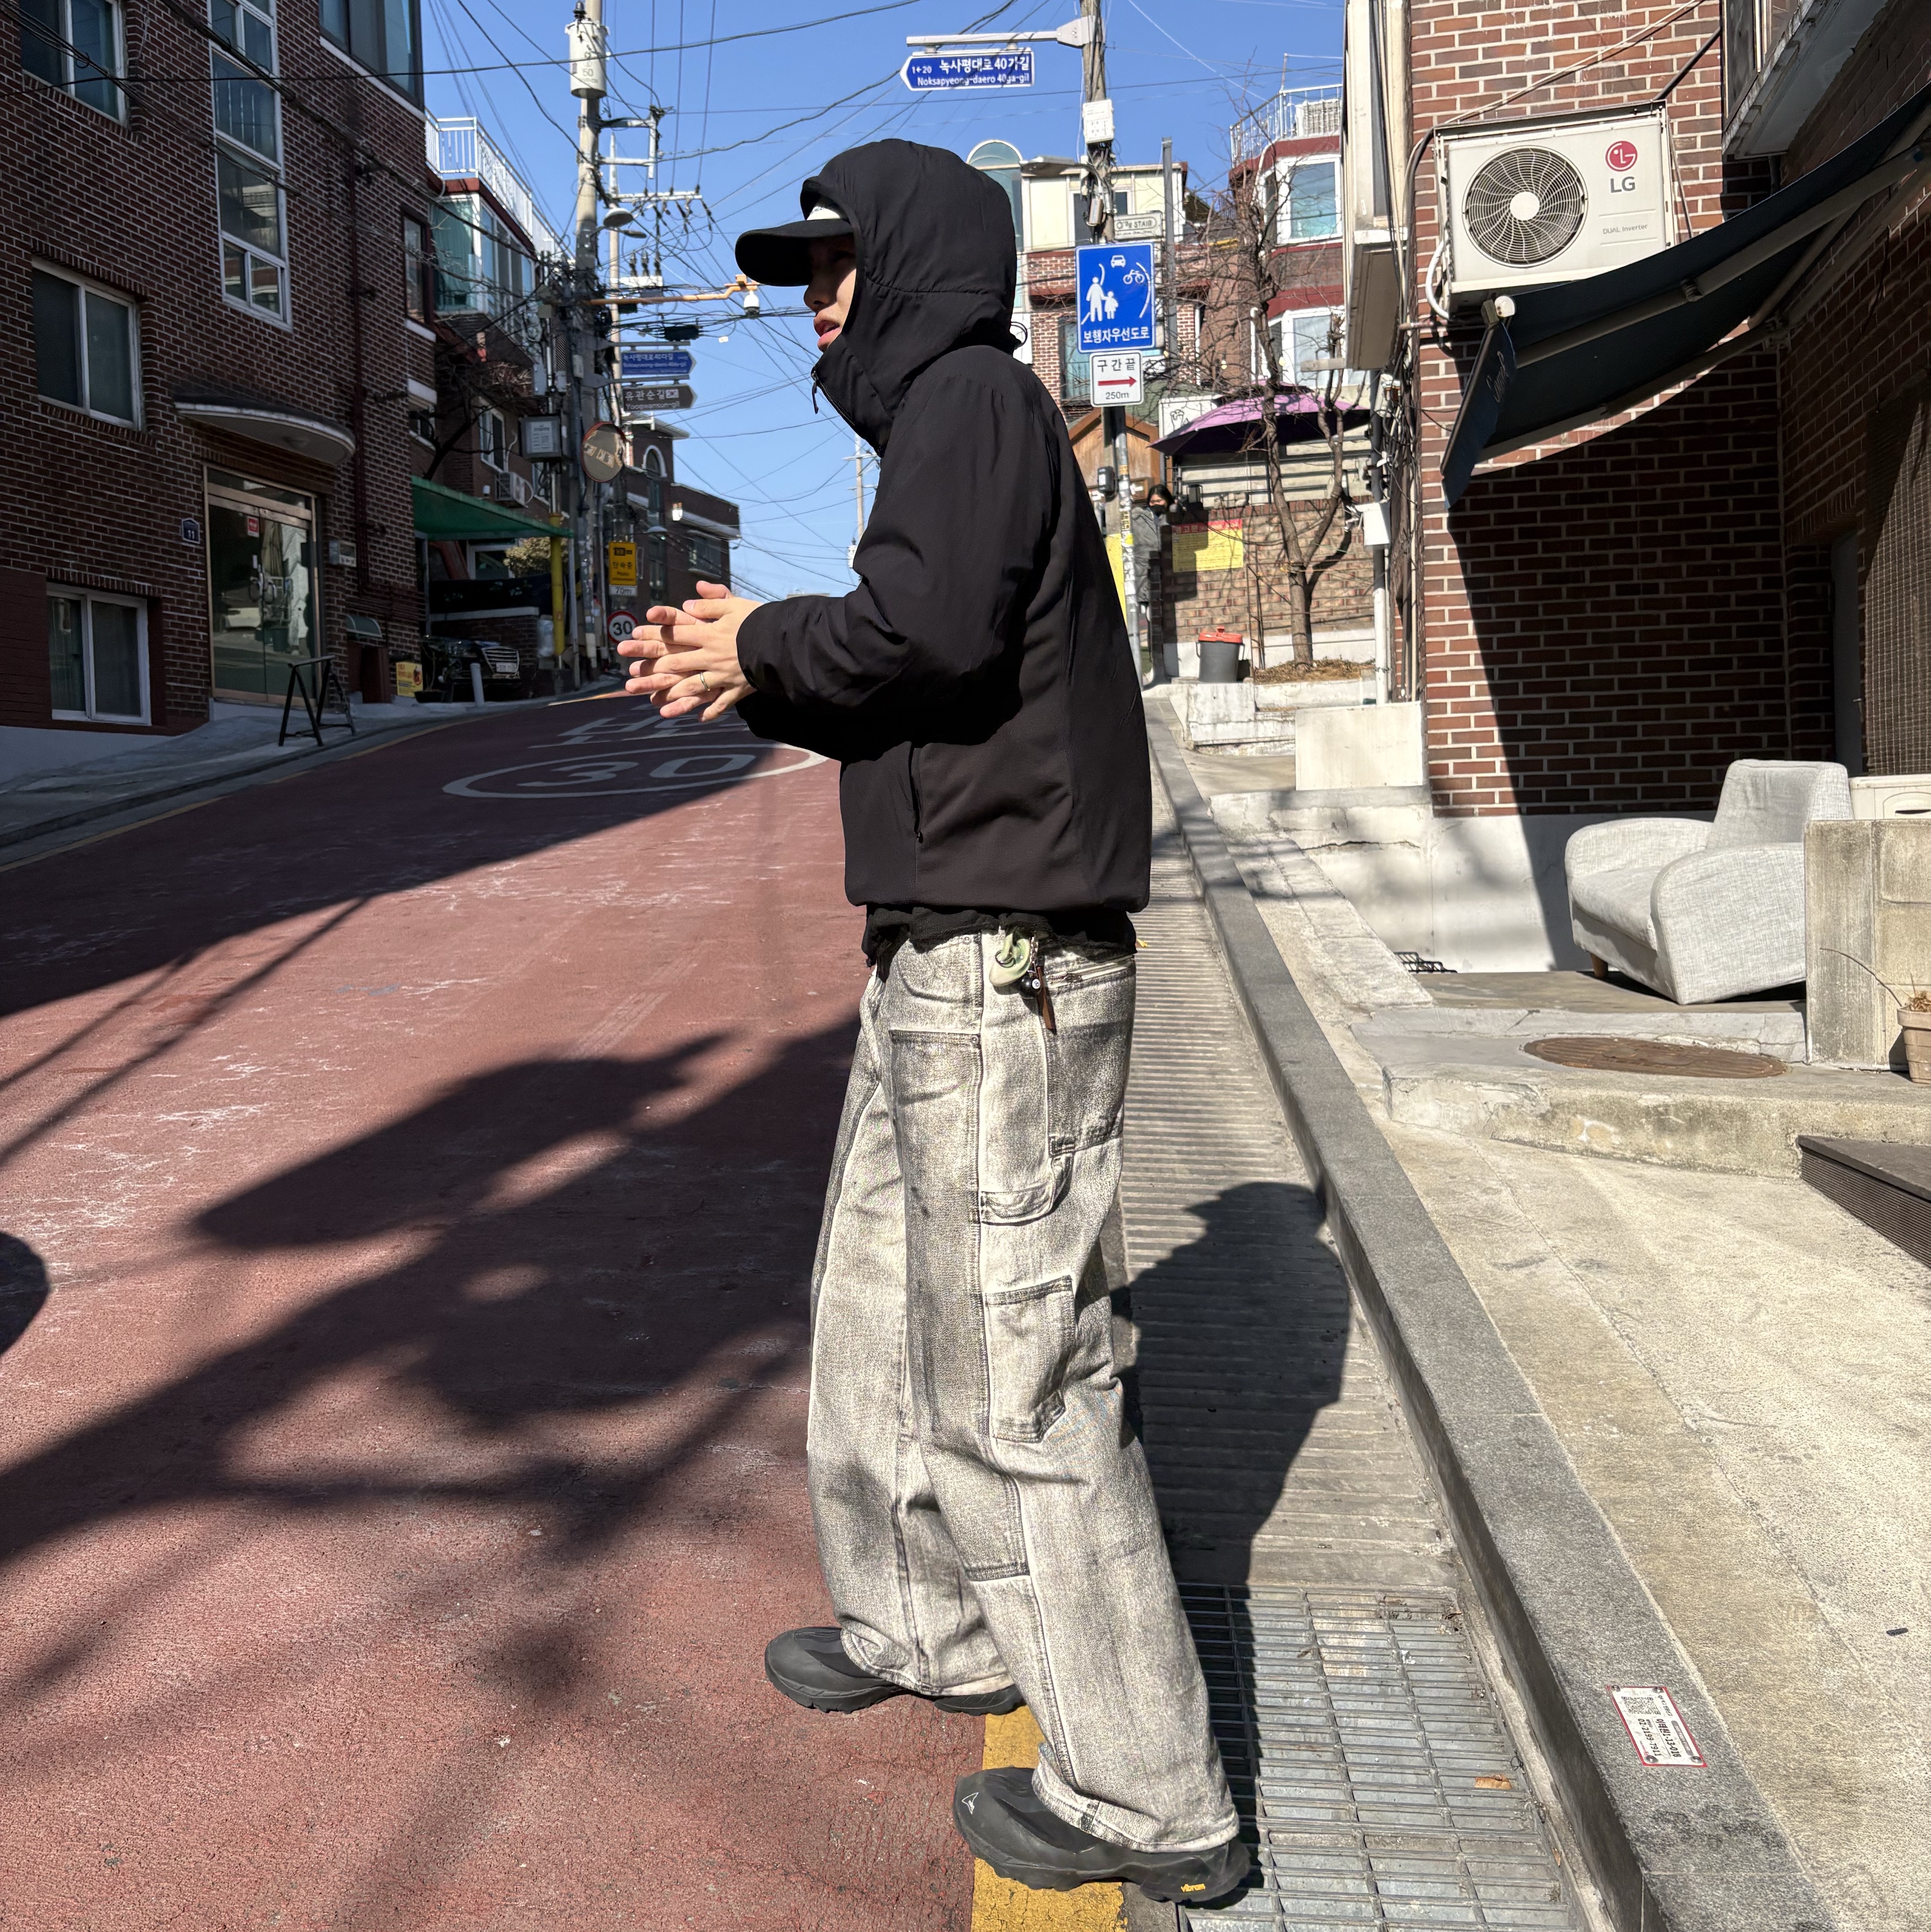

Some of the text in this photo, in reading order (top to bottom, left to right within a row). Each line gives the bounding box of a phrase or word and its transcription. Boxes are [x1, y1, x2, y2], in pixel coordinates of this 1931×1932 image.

[1610, 176, 1636, 193] LG
[1603, 224, 1648, 234] DUAL Inverter
[1083, 326, 1150, 343] 보행자우선도로
[625, 390, 665, 401] 유관순길
[1105, 391, 1129, 399] 250m
[612, 620, 632, 636] 30
[517, 754, 756, 787] 30
